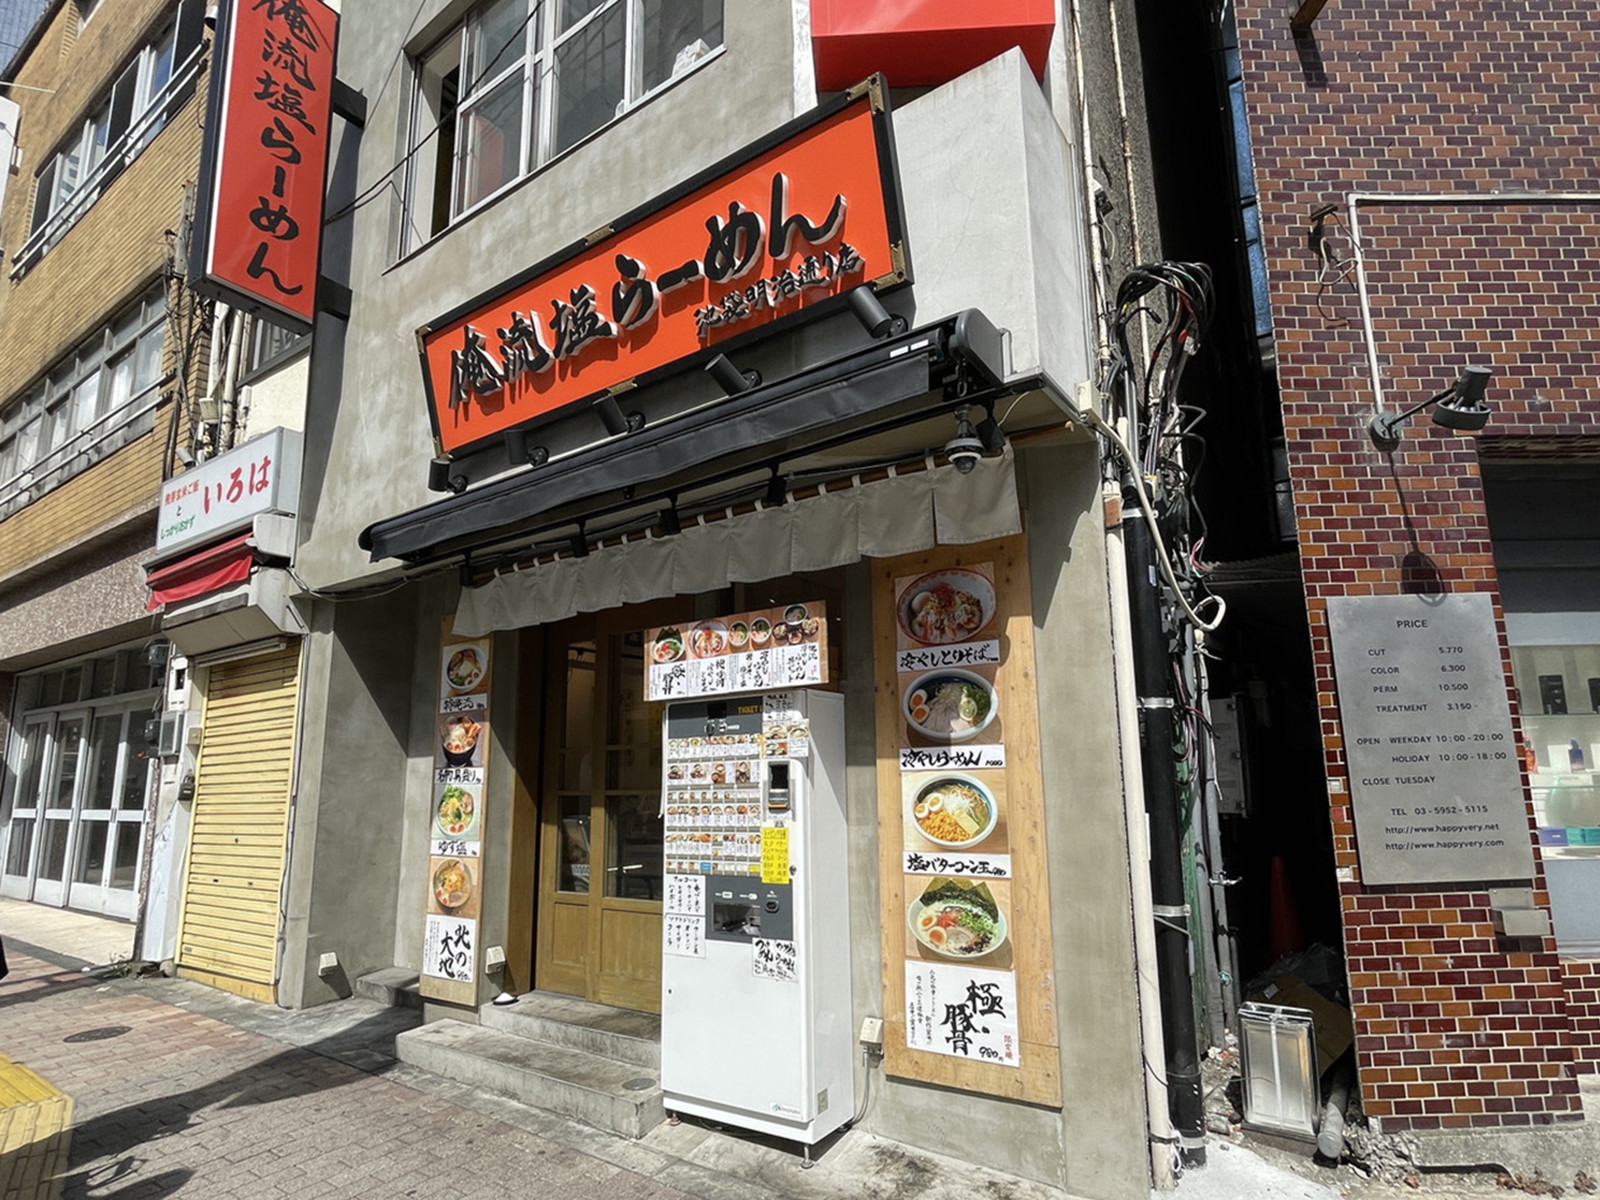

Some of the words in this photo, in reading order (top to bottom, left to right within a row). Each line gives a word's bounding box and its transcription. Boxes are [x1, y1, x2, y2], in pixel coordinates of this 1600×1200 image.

[247, 0, 321, 296] 俺流塩らーめん
[448, 172, 848, 410] 俺流塩らーめん
[694, 242, 866, 337] 池袋明治通り店
[203, 455, 272, 514] いろは
[1396, 619, 1429, 629] PRICE
[1367, 648, 1386, 657] CUT
[1370, 666, 1400, 675] COLOR
[1373, 685, 1398, 693] PERM
[1376, 704, 1428, 713] TREATMENT
[1356, 737, 1381, 745] OPEN
[1389, 736, 1432, 744] WEEKDAY
[1392, 754, 1430, 763] HOLIDAY
[1362, 777, 1390, 786] CLOSE
[1395, 776, 1436, 785] TUESDAY
[1391, 807, 1408, 816] TEL
[1385, 823, 1500, 835] http://www.happyvery.net
[1385, 839, 1505, 851] http://www.happyvery.com
